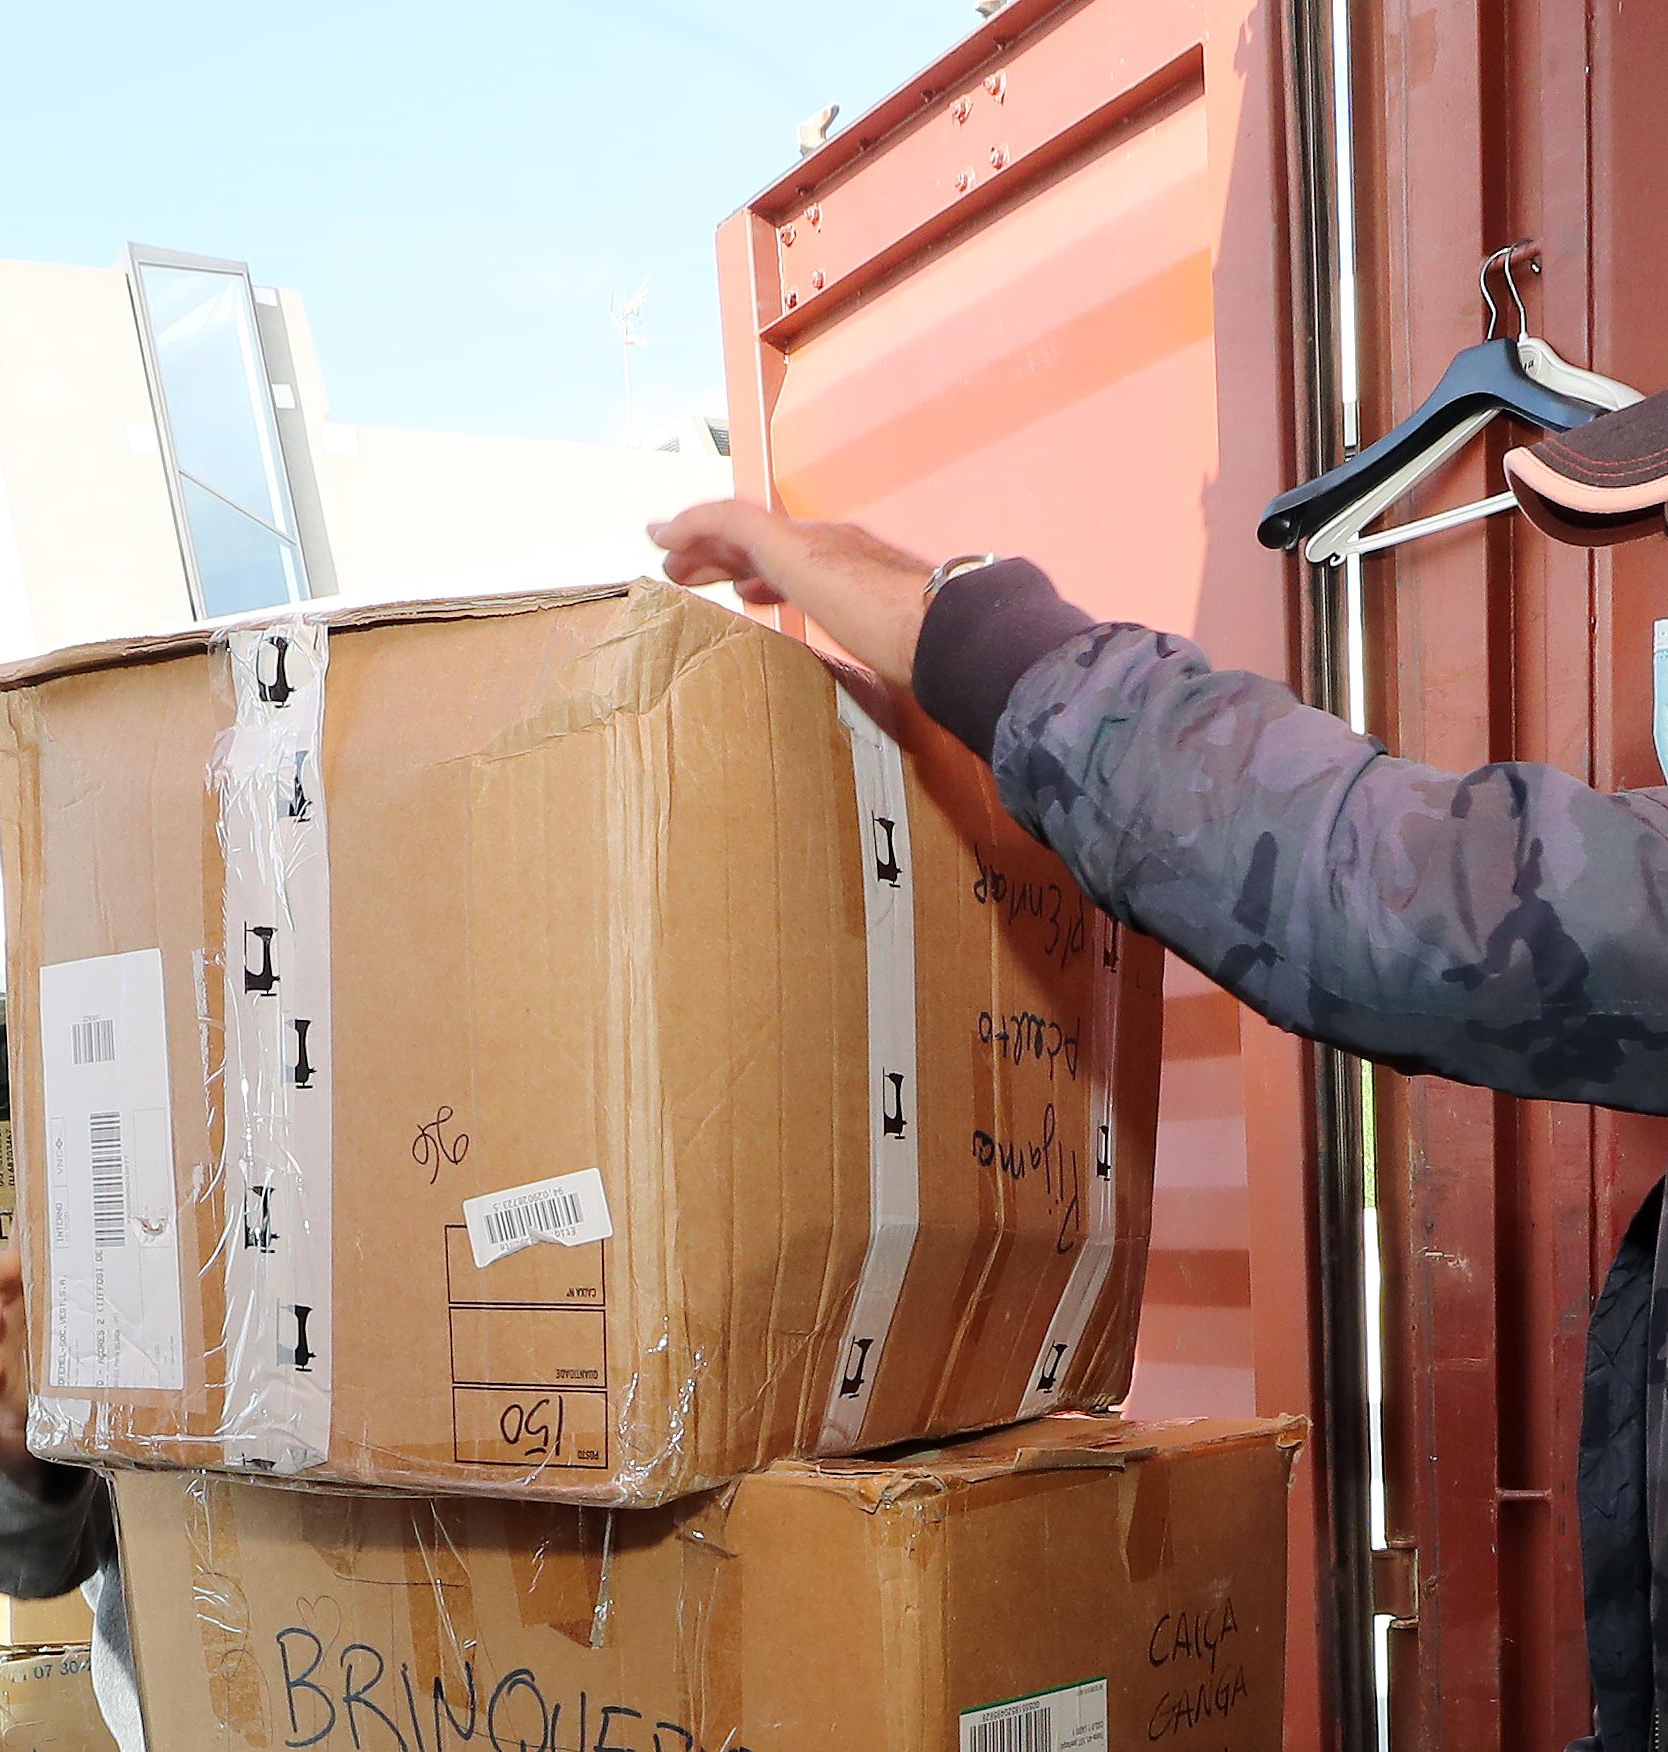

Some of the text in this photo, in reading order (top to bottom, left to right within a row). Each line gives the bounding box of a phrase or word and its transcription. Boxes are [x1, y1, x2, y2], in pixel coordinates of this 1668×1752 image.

[576, 1287, 597, 1298] CAIXA
[96, 1329, 107, 1364] AÇORES
[555, 1368, 598, 1380] QUANTIDADE
[500, 1396, 564, 1457] 150
[34, 1664, 52, 1680] 07
[1147, 1662, 1249, 1741] GANGA
